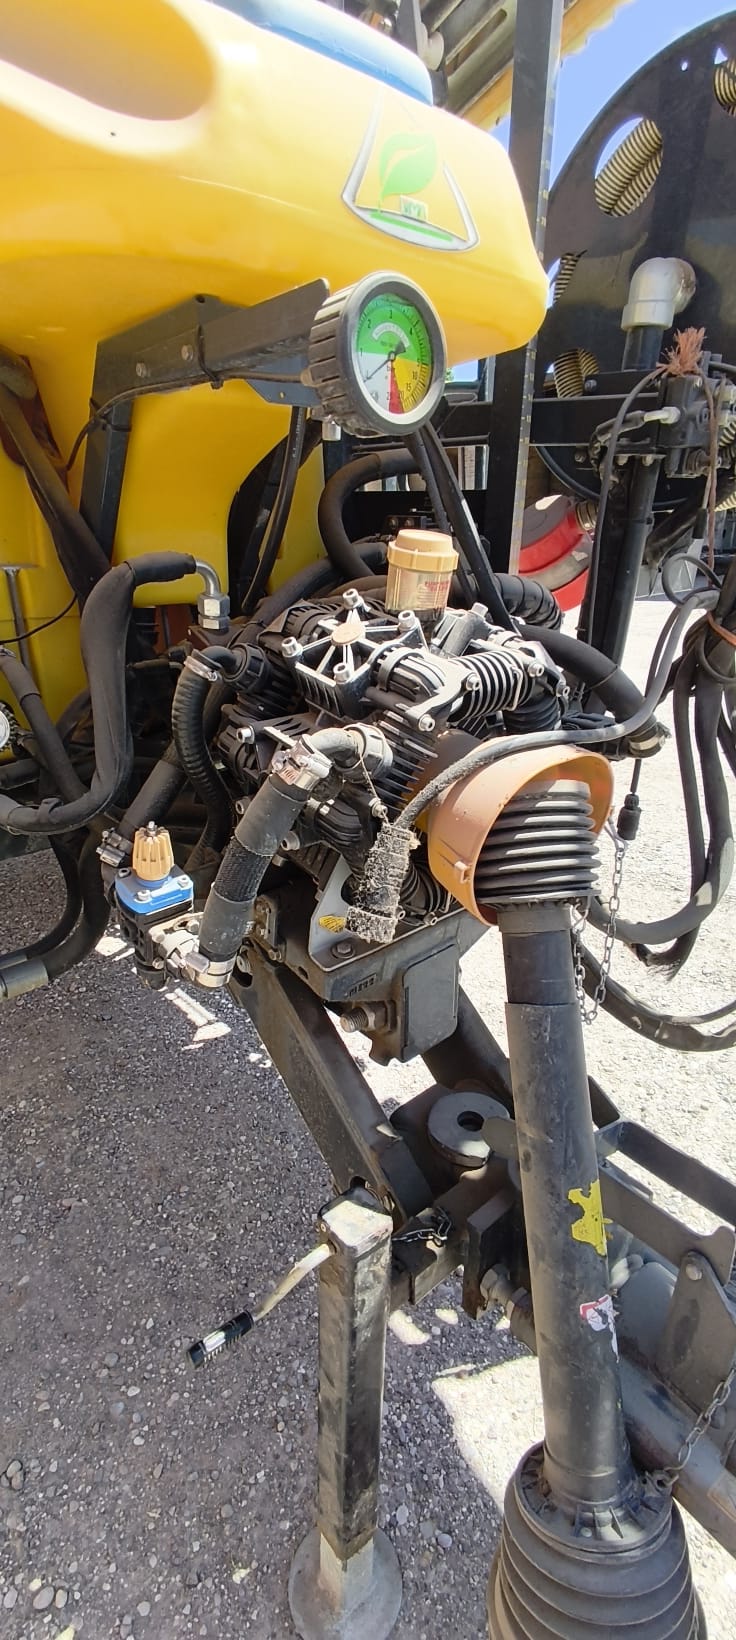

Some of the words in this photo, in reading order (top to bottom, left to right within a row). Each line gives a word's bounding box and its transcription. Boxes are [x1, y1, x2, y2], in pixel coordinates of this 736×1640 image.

[367, 318, 372, 329] 2
[412, 370, 418, 381] 10
[405, 382, 411, 392] 15
